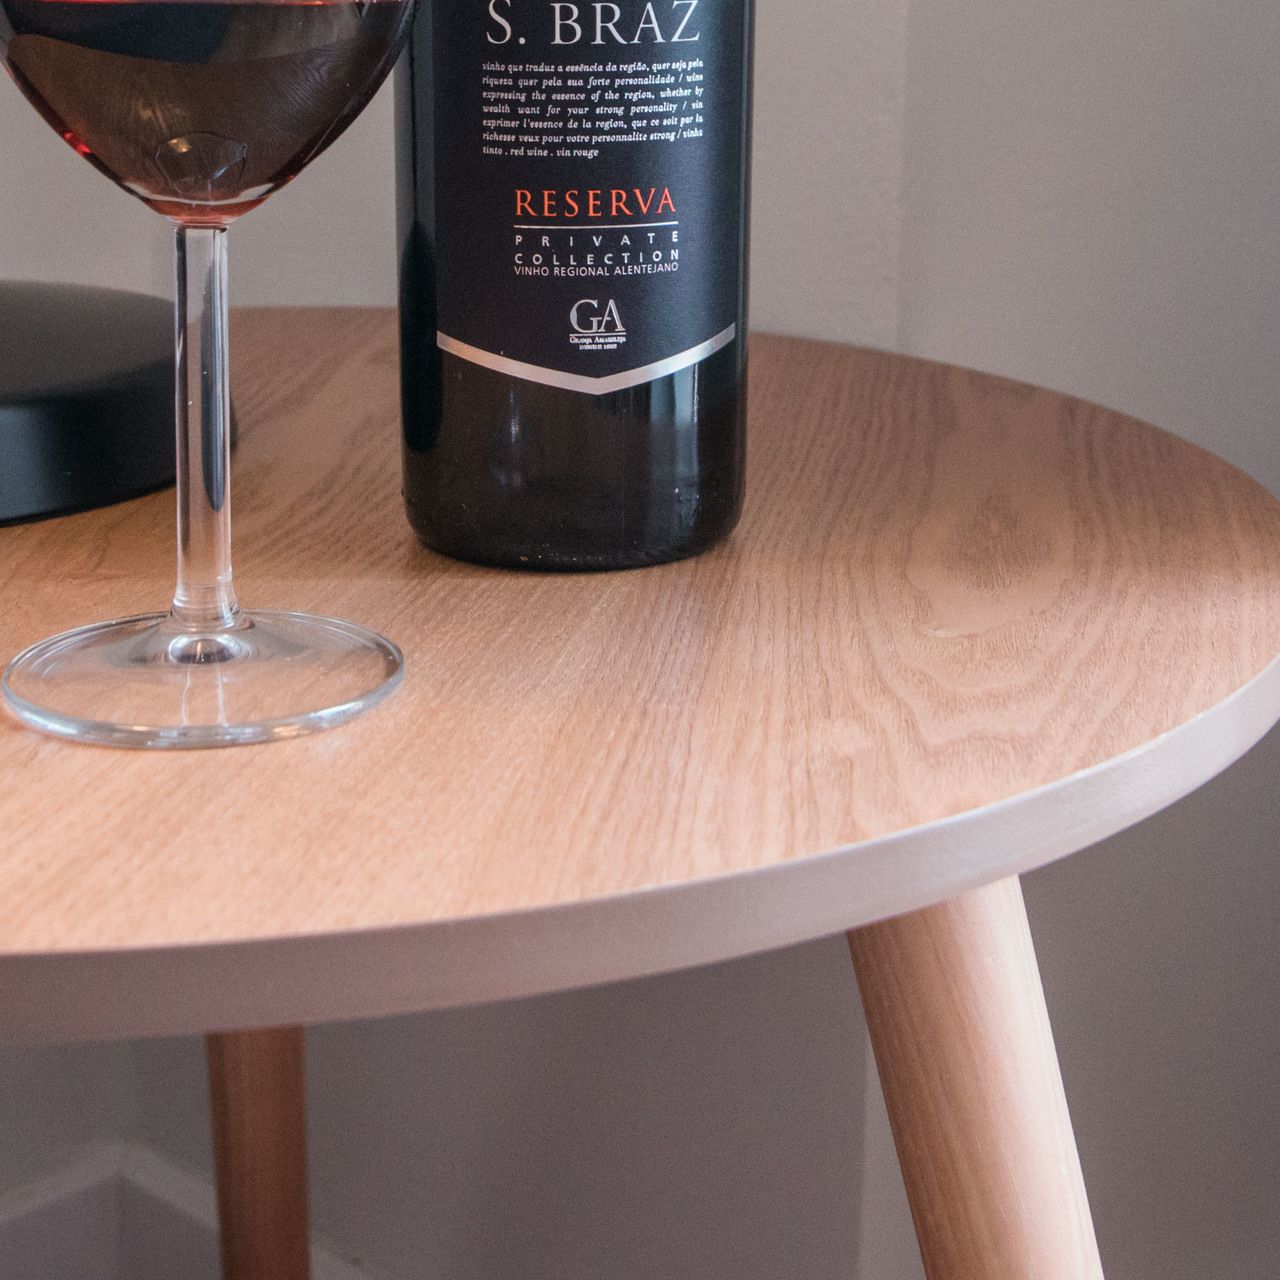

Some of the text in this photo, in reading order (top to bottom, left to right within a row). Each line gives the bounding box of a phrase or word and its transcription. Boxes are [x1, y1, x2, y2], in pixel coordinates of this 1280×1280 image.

[550, 0, 700, 45] BRAZ
[482, 61, 505, 71] vinho
[507, 64, 523, 74] que
[525, 62, 555, 72] traduz
[605, 61, 618, 72] da
[619, 61, 649, 74] região,
[652, 62, 670, 73] quer
[688, 58, 703, 71] pela
[482, 76, 513, 87] riqueza
[518, 78, 538, 88] quer
[542, 77, 562, 88] pela
[567, 78, 584, 87] sua
[587, 75, 611, 89] forte
[614, 74, 675, 88] personalidade
[686, 73, 703, 82] wine
[483, 86, 703, 102] expressing the essence of the region, whether by
[483, 103, 510, 113] wealth
[518, 106, 540, 114] want
[546, 104, 561, 116] for
[567, 106, 589, 116] your
[596, 106, 624, 116] strong
[630, 102, 678, 115] personality
[692, 100, 703, 109] vin
[483, 118, 520, 129] exprimer
[567, 119, 578, 128] de
[583, 119, 591, 128] la
[596, 118, 627, 130] region,
[632, 119, 647, 129] que
[650, 119, 660, 127] ce
[663, 116, 678, 127] soit
[680, 117, 694, 127] par
[695, 114, 703, 123] la
[483, 132, 516, 141] richesse
[519, 134, 540, 142] veux
[542, 135, 563, 144] pour
[567, 133, 590, 142] votre
[650, 130, 675, 141] strong
[682, 128, 703, 138] vinho
[483, 146, 503, 156] tinto
[510, 147, 525, 156] red
[527, 148, 548, 156] wine
[556, 148, 571, 157] vin
[573, 148, 599, 158] rouge
[514, 187, 677, 217] RESERVA
[514, 230, 679, 246] PRIVATE
[514, 249, 679, 265] COLLECTION
[514, 262, 679, 276] VINHO REGIONAL ALENTEJANO
[569, 298, 626, 332] GA
